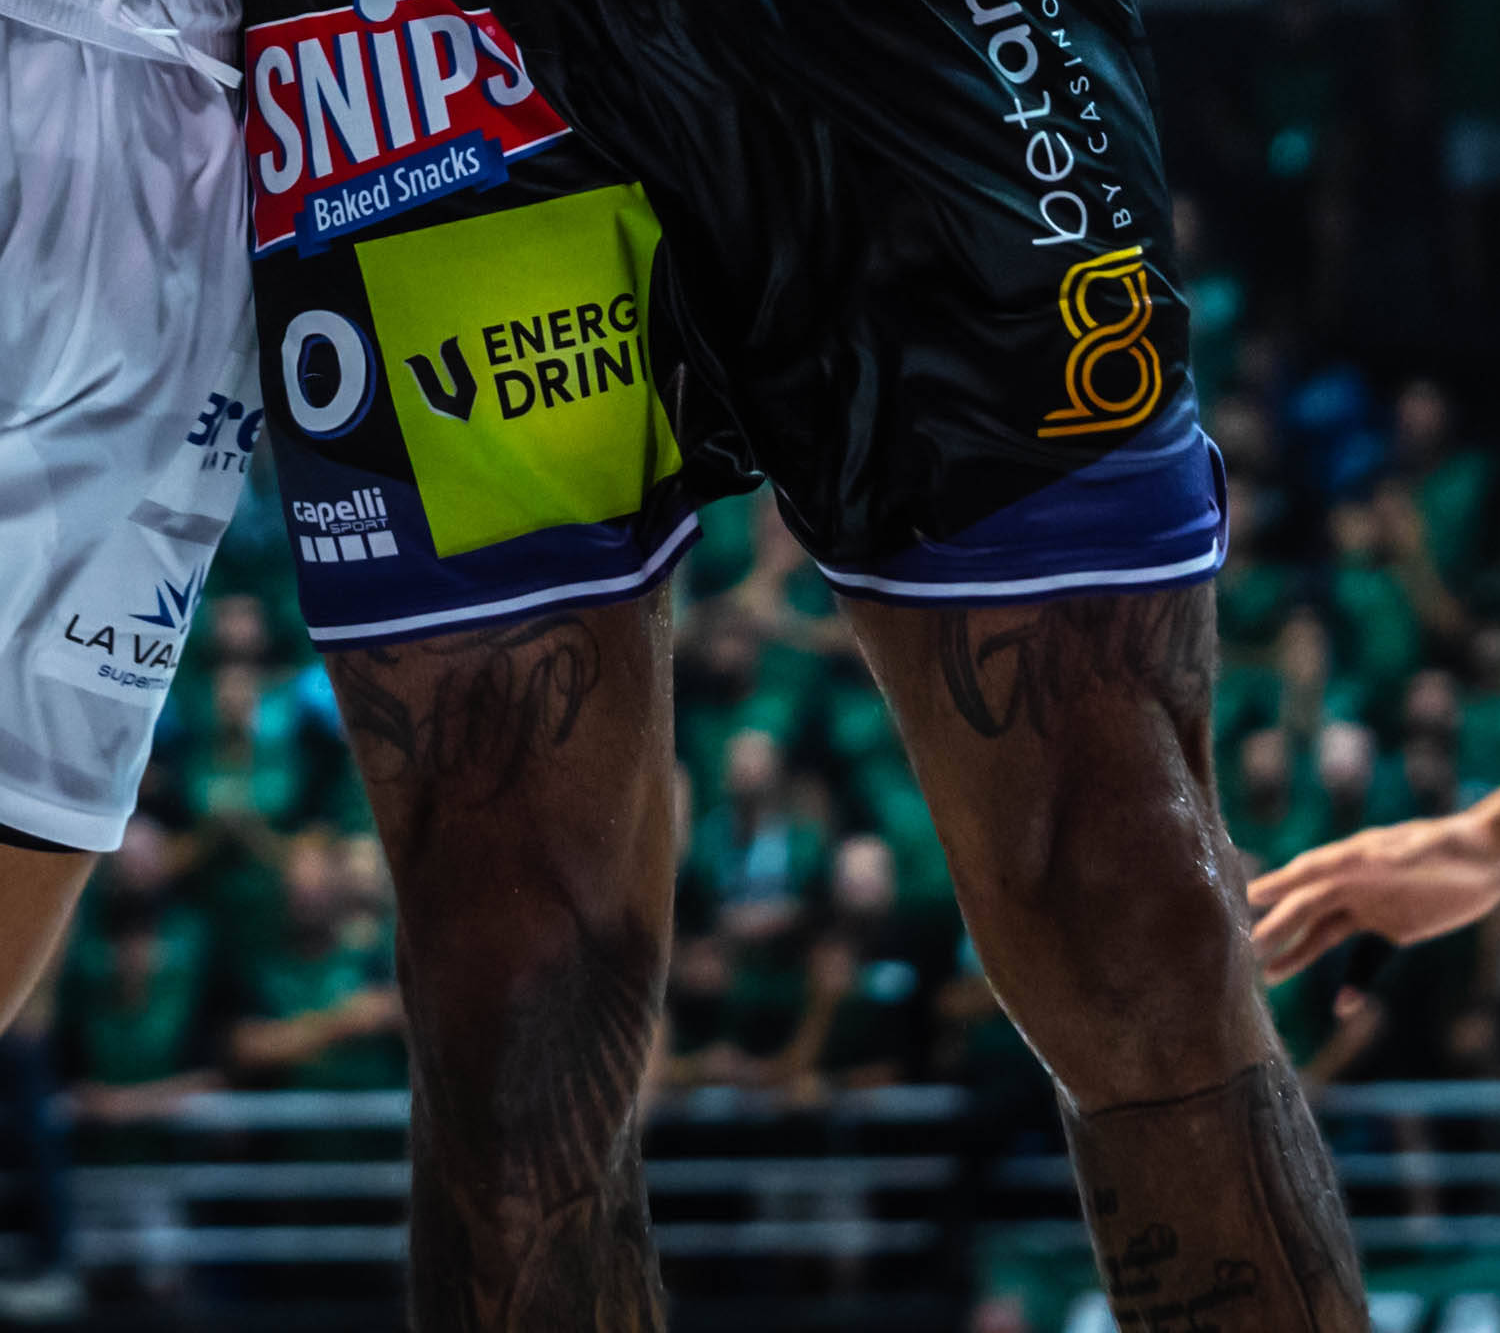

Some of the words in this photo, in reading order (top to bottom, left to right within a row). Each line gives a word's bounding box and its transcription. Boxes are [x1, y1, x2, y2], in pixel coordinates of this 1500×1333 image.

[313, 180, 391, 232] Baked
[395, 145, 482, 203] Snacks
[1100, 181, 1134, 231] BY
[481, 292, 638, 366] ENERG
[281, 309, 376, 439] 0
[292, 486, 388, 531] capelli
[329, 517, 389, 534] SPORT
[64, 613, 115, 656] LA
